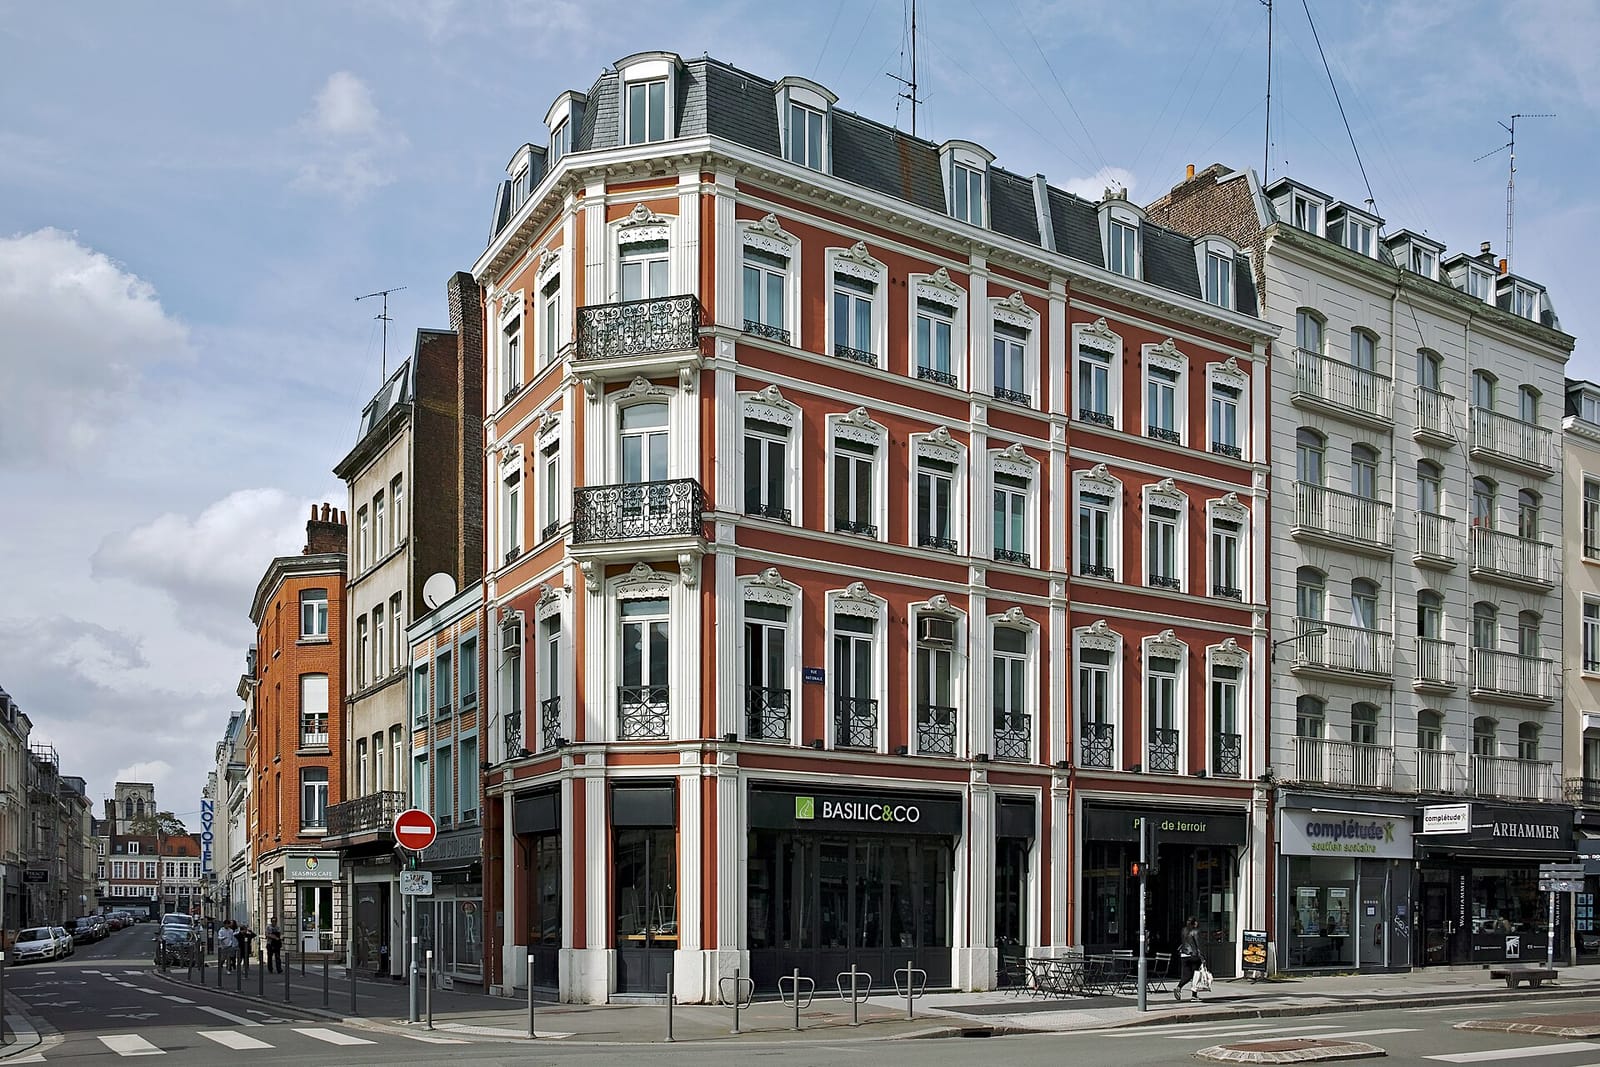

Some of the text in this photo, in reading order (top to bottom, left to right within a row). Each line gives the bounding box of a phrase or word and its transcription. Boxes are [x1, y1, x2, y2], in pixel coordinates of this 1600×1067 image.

[822, 801, 920, 823] BASILIC&CO
[1425, 813, 1461, 823] complétude
[1161, 820, 1175, 831] de
[1176, 820, 1207, 832] terroir
[1306, 819, 1384, 842] complétude
[1492, 822, 1560, 839] ARHAMMER
[201, 800, 214, 872] NOVOTEL
[1311, 841, 1377, 854] soutien scolaire
